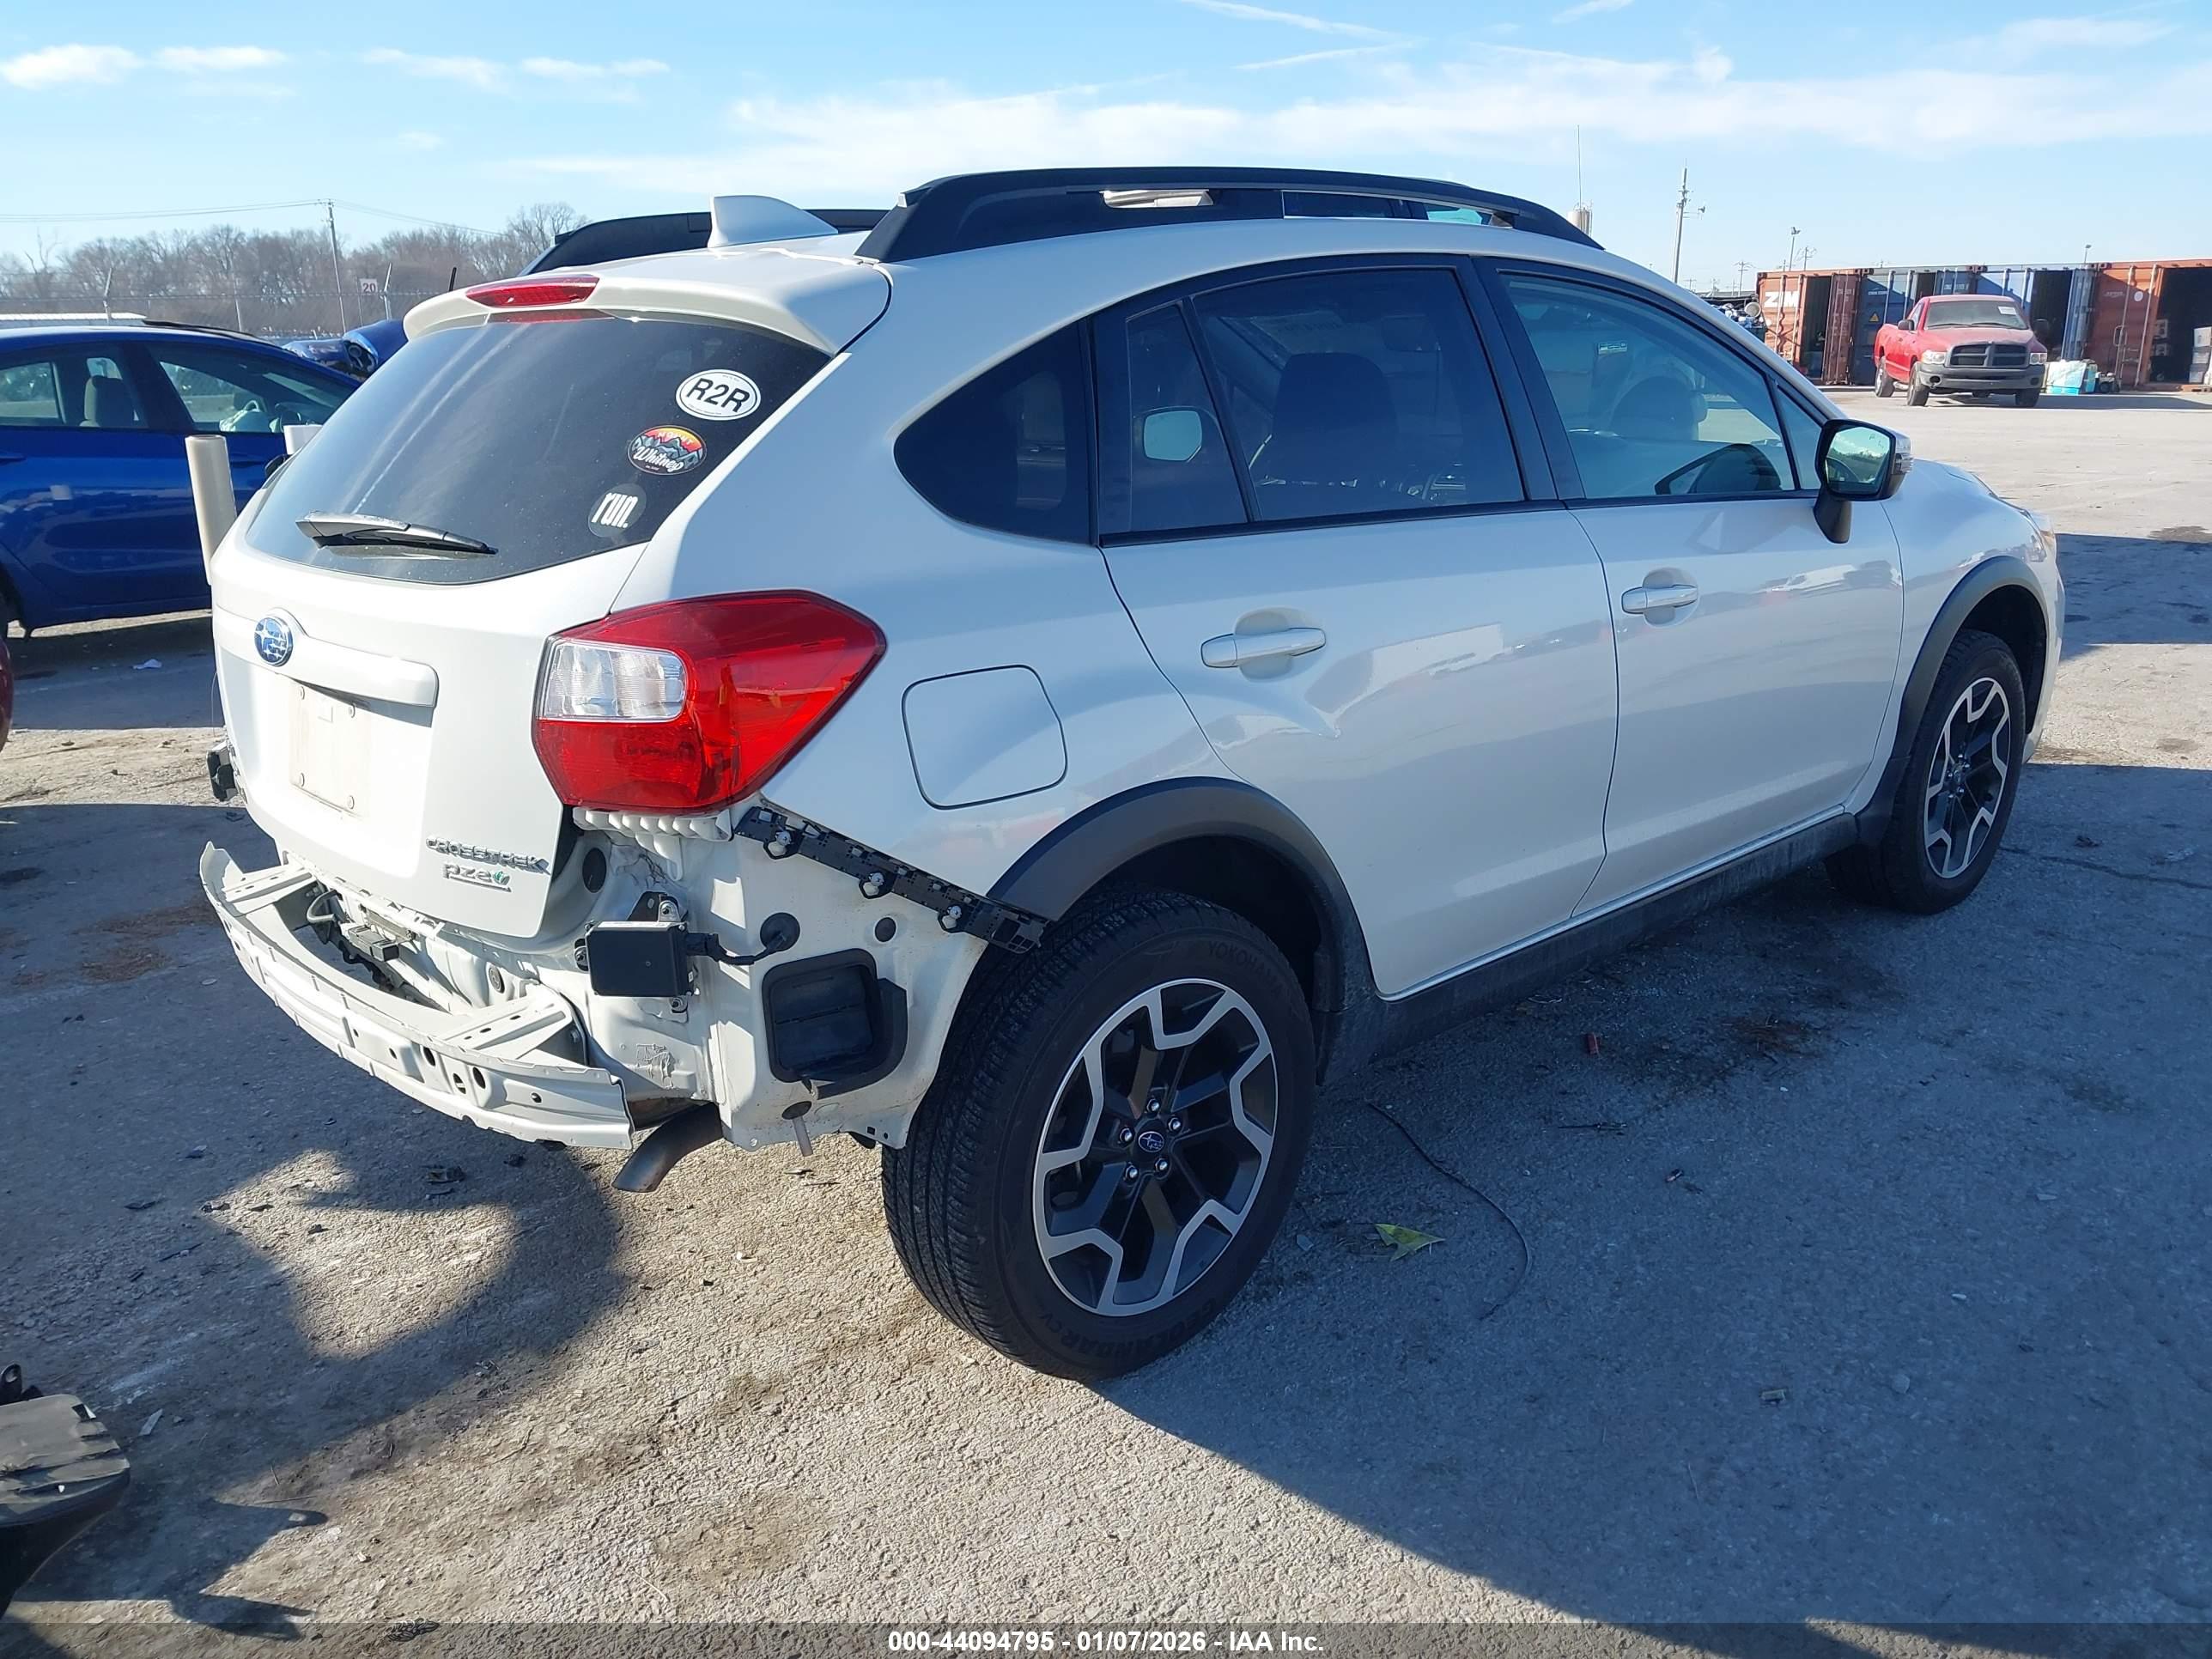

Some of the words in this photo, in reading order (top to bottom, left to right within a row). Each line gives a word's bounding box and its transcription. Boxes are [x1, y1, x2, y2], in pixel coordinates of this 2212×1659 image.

[362, 282, 376, 292] 20
[686, 378, 750, 412] R2R
[634, 446, 684, 472] Whitney
[426, 836, 551, 876] CROSSTREK
